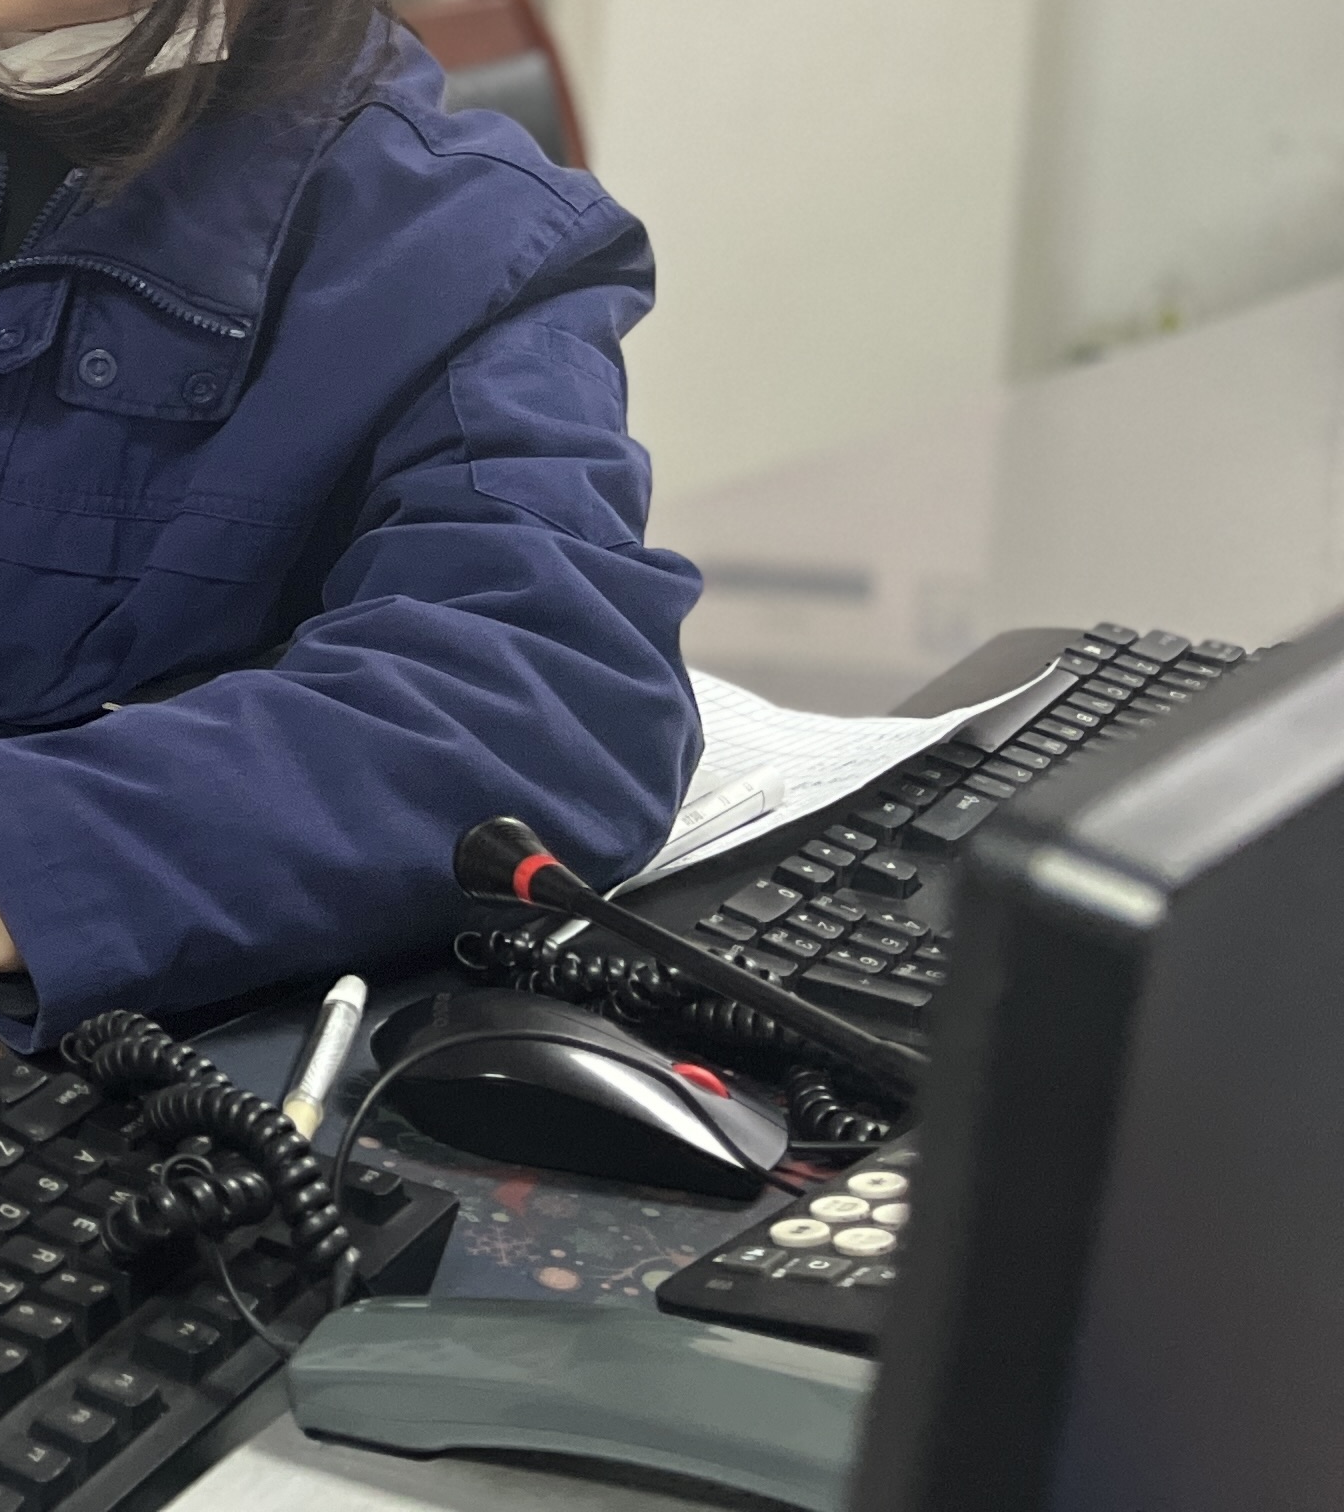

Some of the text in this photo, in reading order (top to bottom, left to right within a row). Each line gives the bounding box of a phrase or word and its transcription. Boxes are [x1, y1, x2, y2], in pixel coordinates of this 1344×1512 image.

[73, 1149, 96, 1163] A
[38, 1177, 59, 1191] S
[73, 1217, 97, 1232] E
[32, 1248, 57, 1263] R
